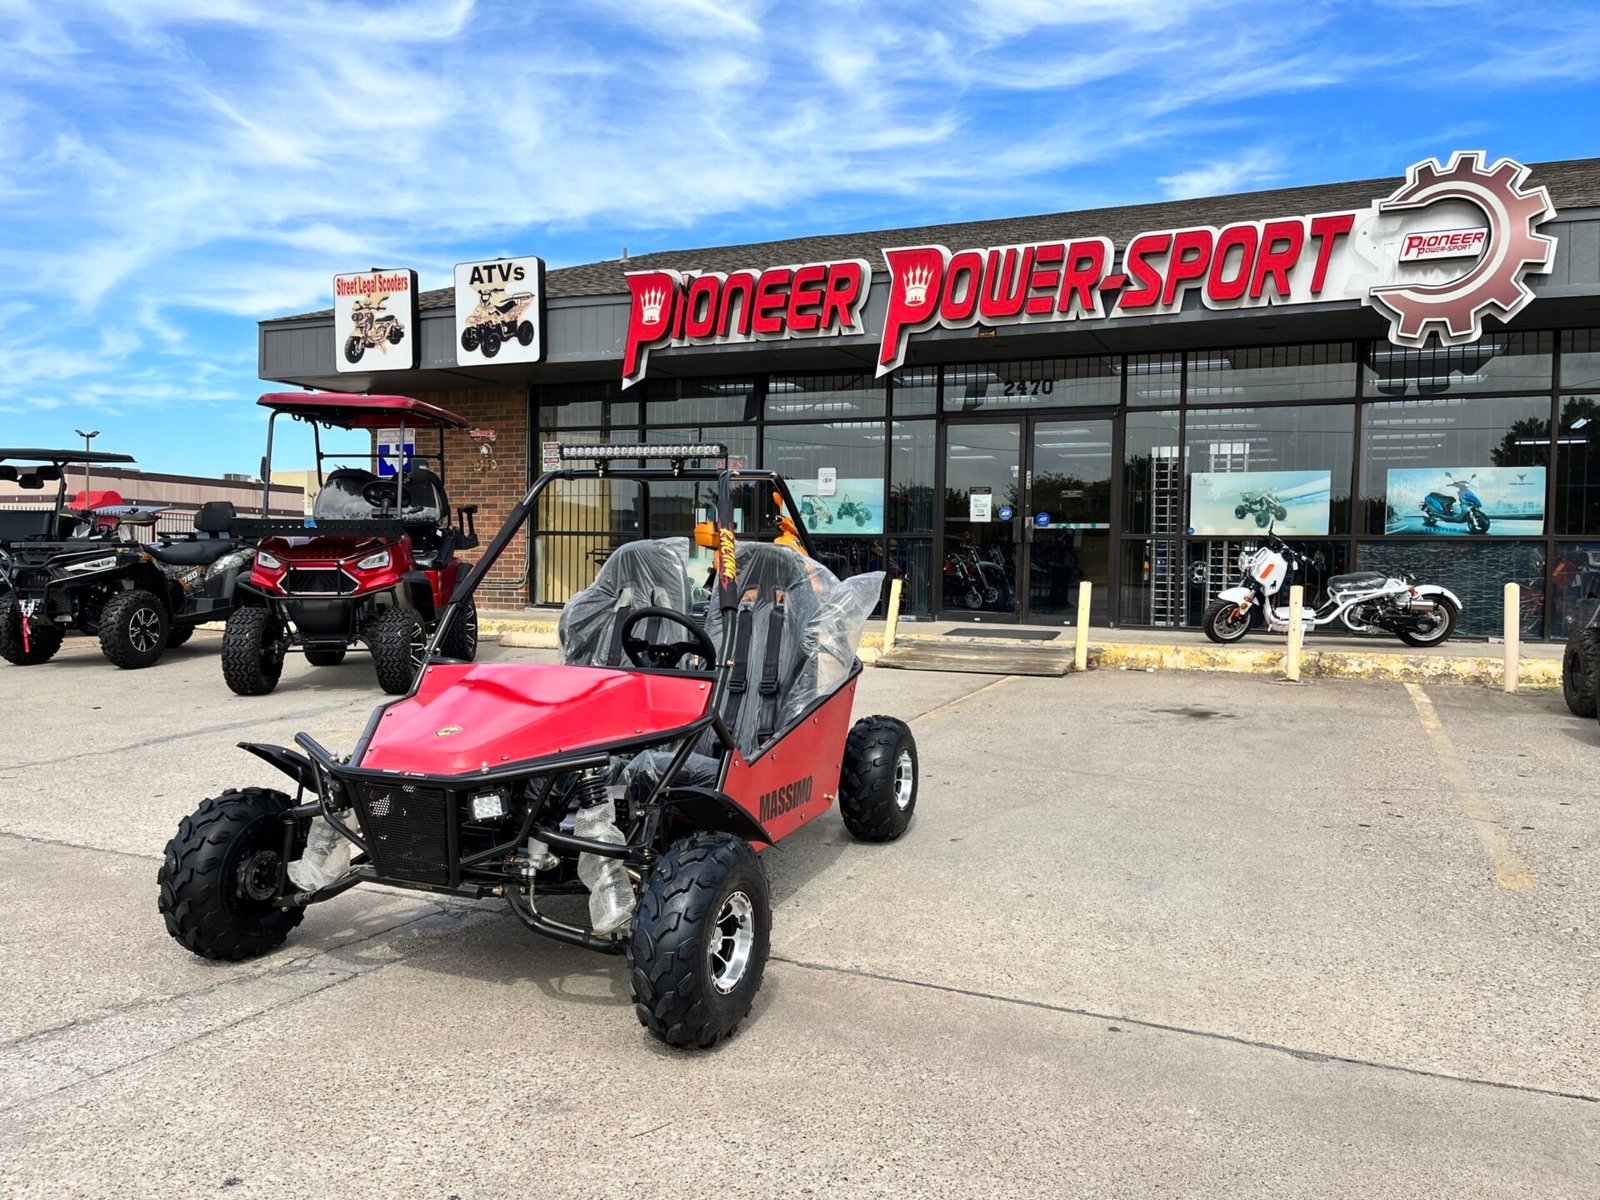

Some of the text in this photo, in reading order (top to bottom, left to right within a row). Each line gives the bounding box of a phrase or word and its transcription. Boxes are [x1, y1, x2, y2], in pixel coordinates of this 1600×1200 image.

[1404, 232, 1484, 256] PIONEER
[1416, 244, 1473, 258] POWER-SPORT
[469, 262, 525, 285] ATVs
[336, 273, 409, 298] Street Legal Scooters
[622, 213, 1356, 378] PIONEER POWER-SPORT
[1003, 379, 1054, 397] 2470
[715, 460, 744, 469] OEN
[759, 775, 813, 825] MASSIMO
